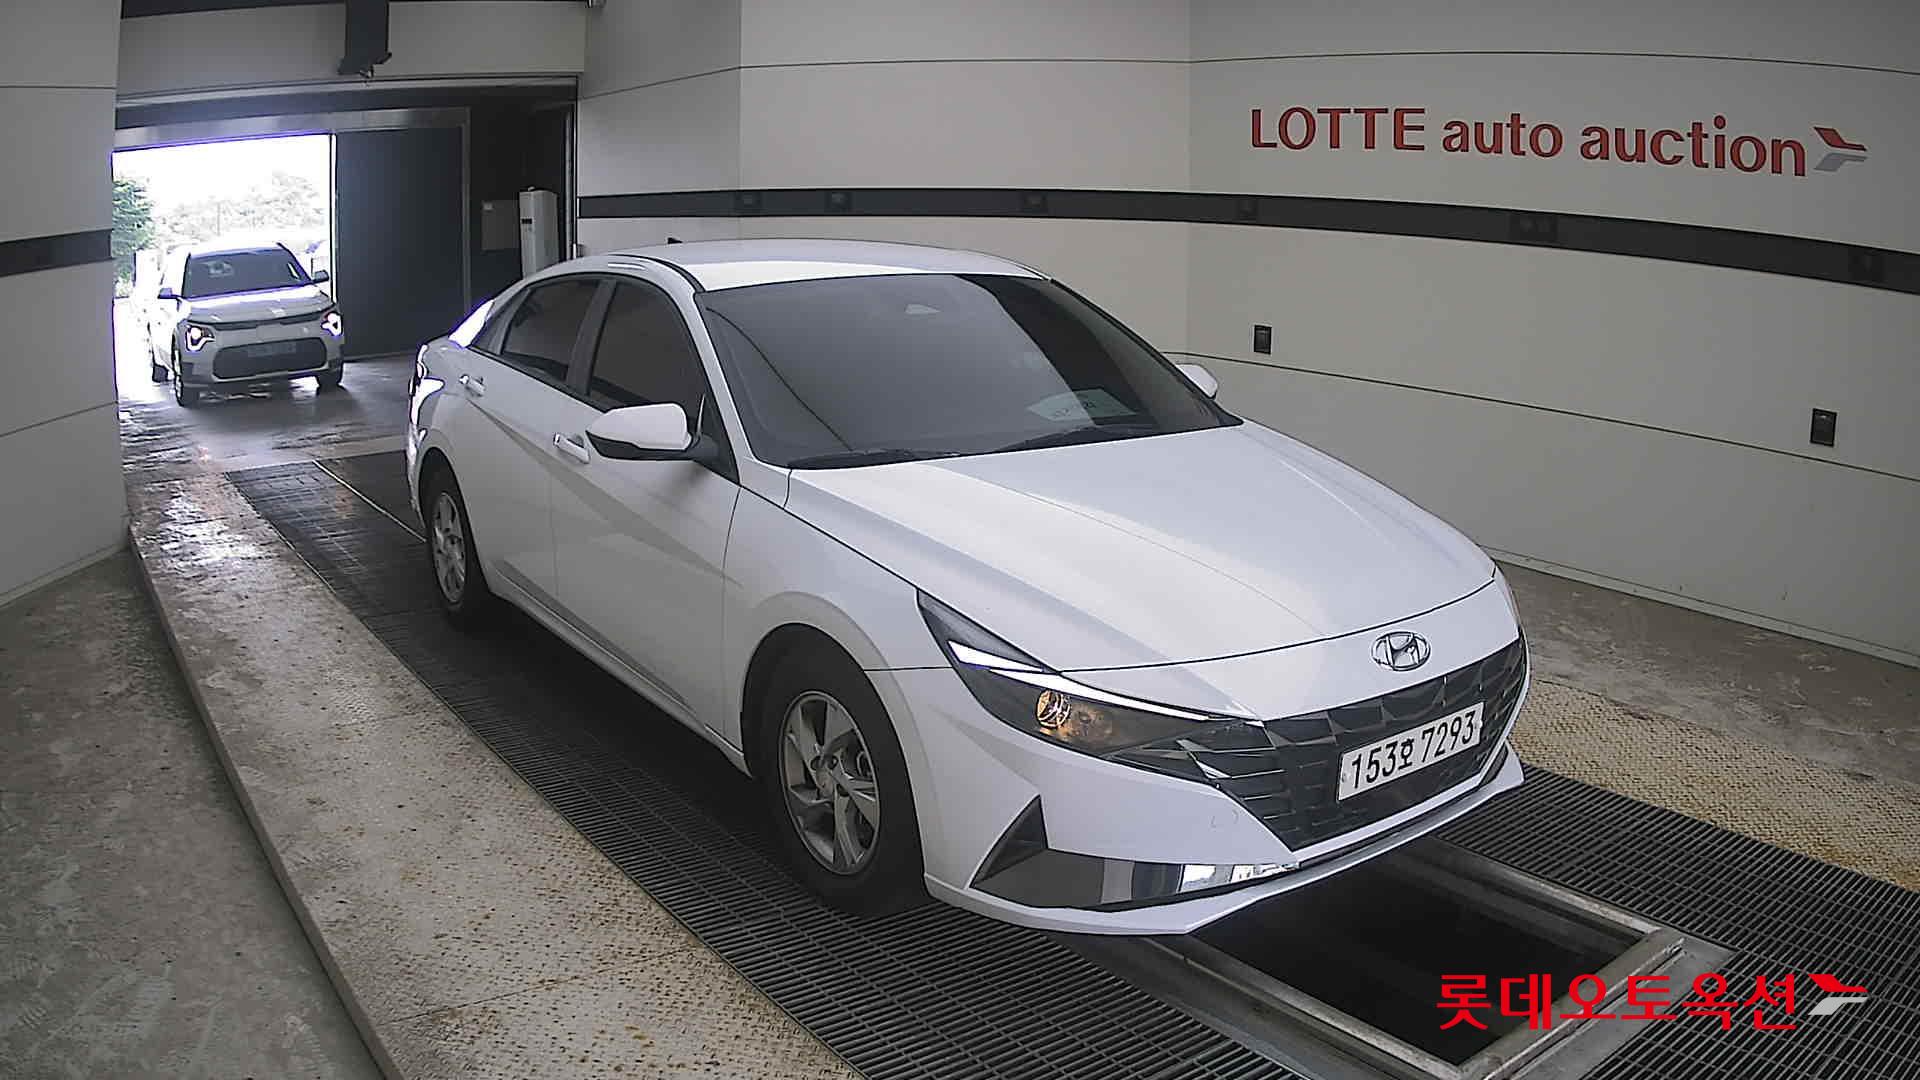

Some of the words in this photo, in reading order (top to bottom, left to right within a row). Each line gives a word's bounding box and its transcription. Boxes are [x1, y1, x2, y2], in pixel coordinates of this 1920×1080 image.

[1251, 107, 1426, 152] LOTTE
[1442, 112, 1564, 157] auto
[1580, 115, 1807, 177] auction
[1421, 710, 1476, 763] 7293
